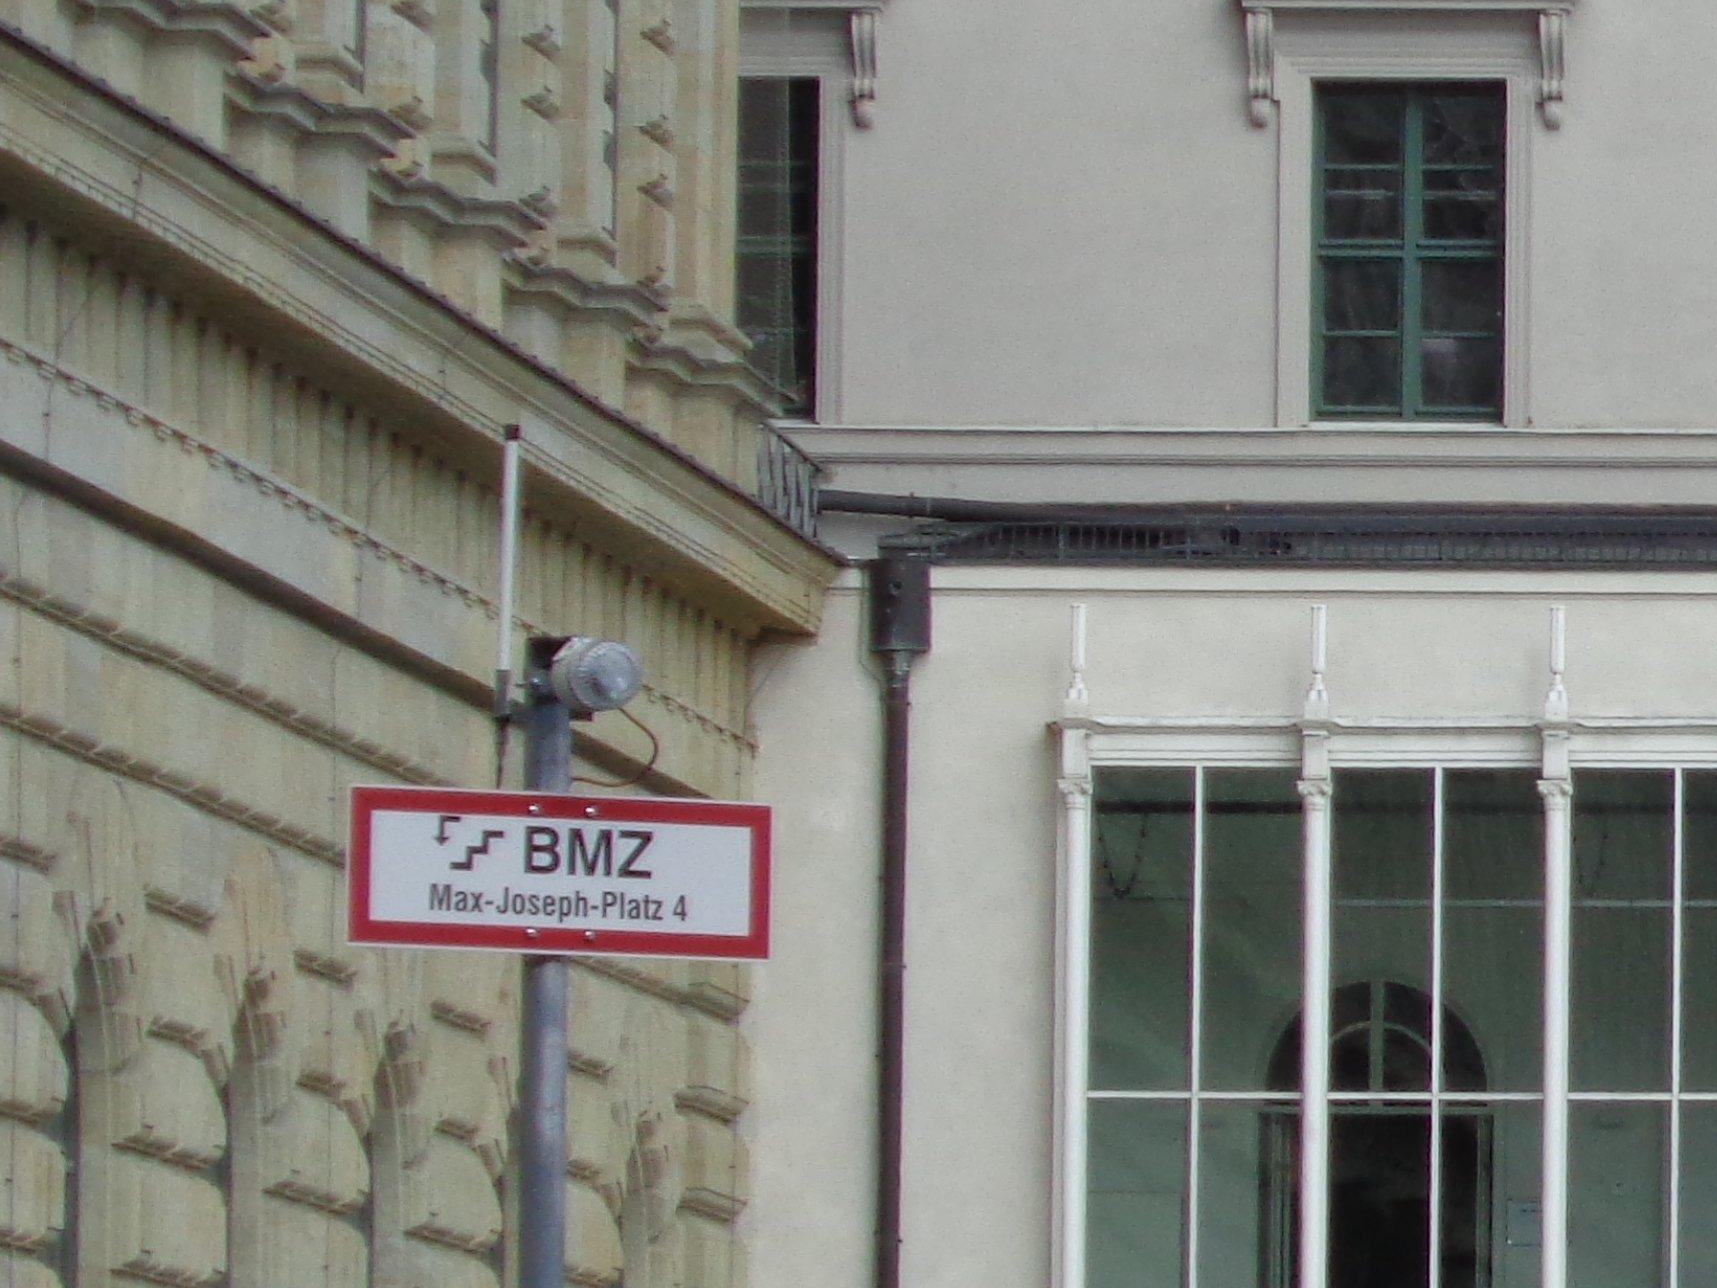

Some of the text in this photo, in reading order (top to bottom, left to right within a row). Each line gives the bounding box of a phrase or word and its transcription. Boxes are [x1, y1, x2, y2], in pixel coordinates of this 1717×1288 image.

[524, 825, 653, 880] BMZ
[428, 882, 688, 924] Max-Joseph-Platz 4
